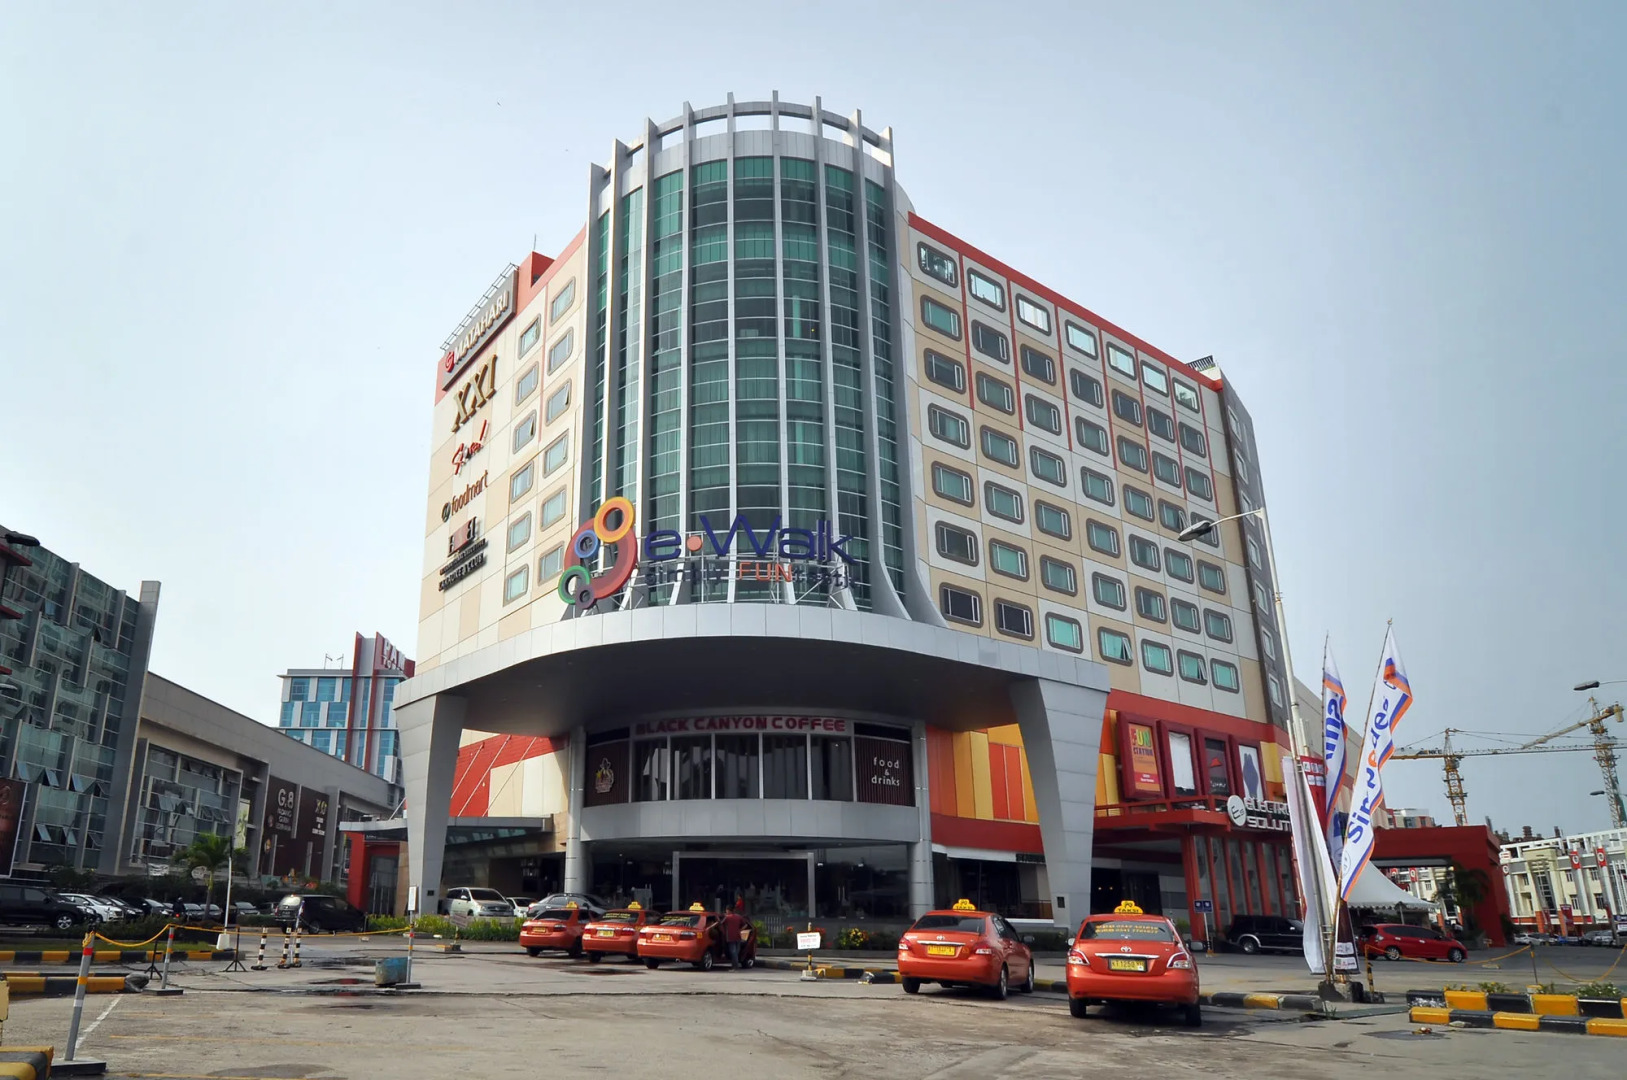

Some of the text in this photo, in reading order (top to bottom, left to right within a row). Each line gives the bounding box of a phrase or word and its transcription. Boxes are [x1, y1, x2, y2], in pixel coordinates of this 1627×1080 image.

[455, 290, 510, 362] MATAHARI
[452, 354, 498, 433] XXI
[451, 470, 489, 517] foodmart
[739, 561, 793, 583] FUN
[635, 715, 845, 735] BLACK CANYON COFFEE
[1130, 728, 1152, 748] FUN
[873, 756, 900, 769] food
[871, 774, 900, 787] drinks
